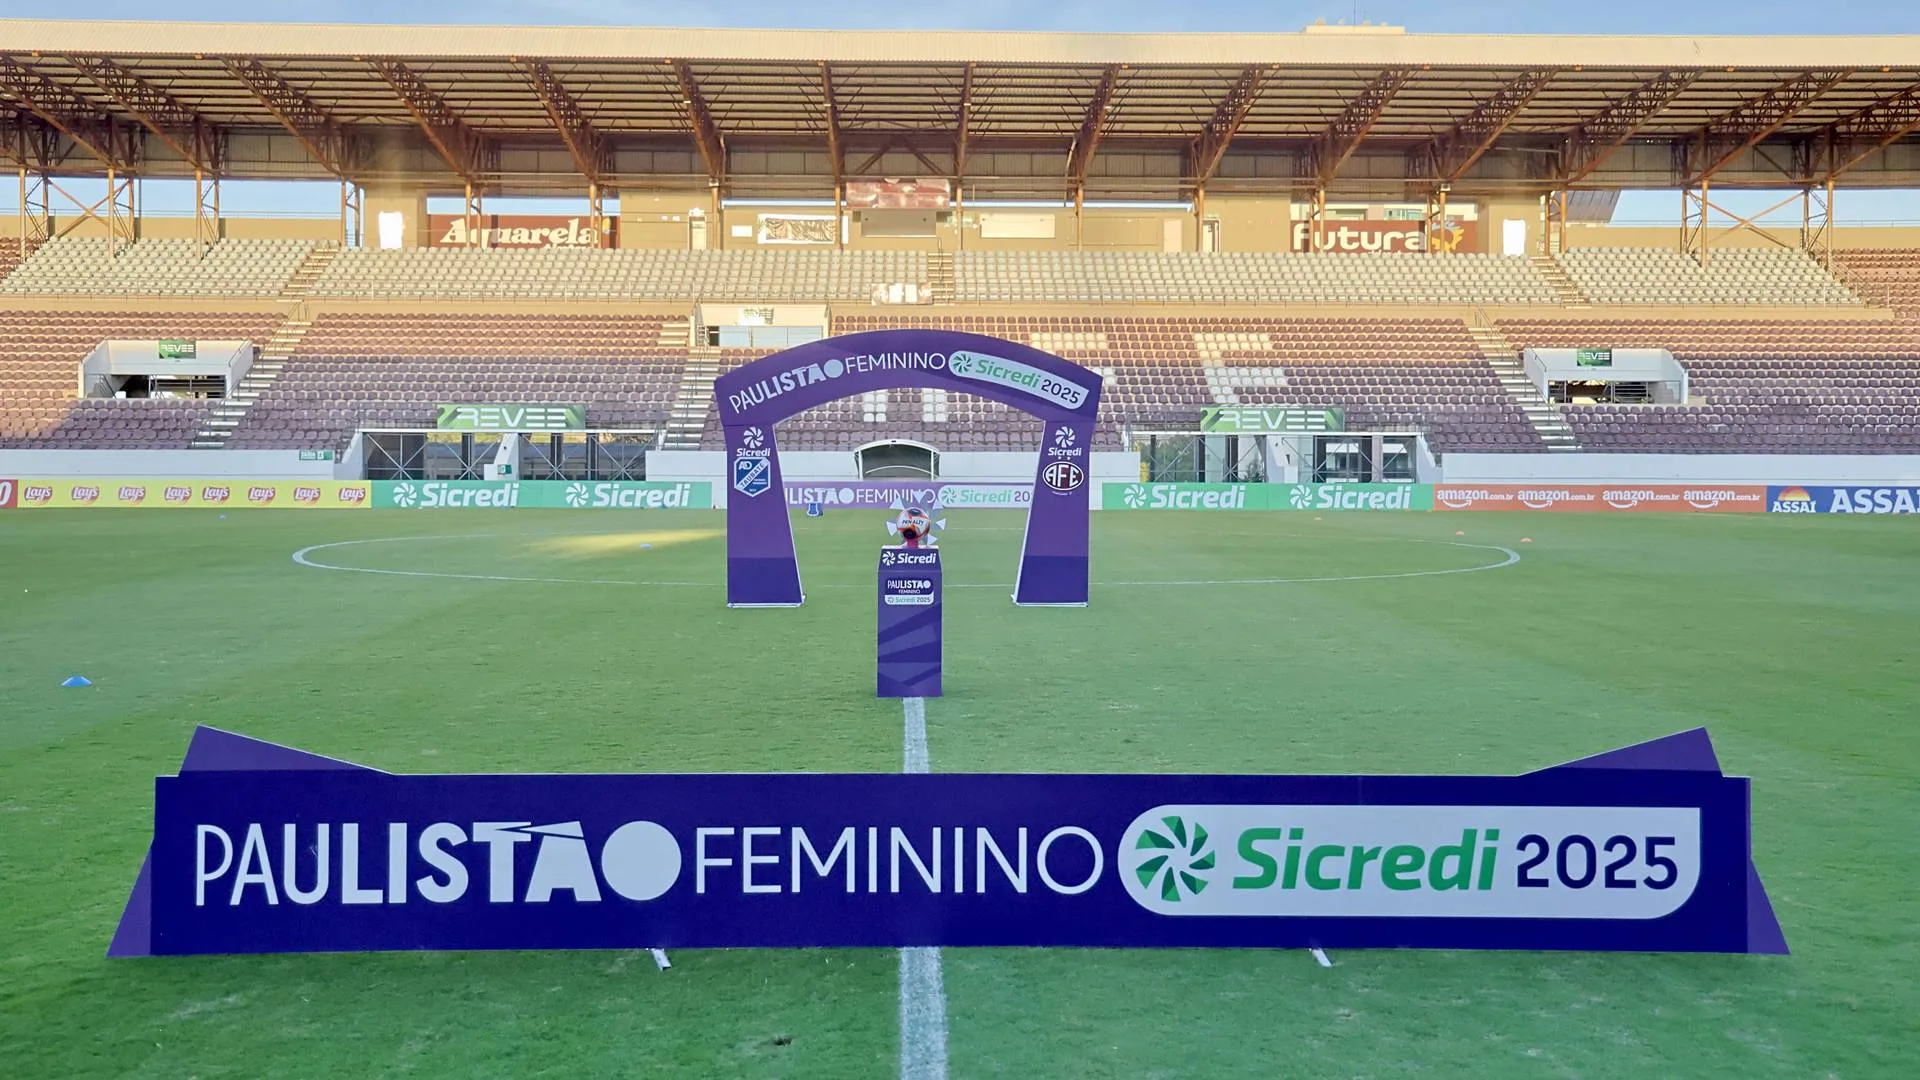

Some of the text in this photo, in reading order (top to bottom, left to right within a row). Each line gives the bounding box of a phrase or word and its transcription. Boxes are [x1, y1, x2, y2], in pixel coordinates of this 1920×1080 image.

[1293, 223, 1427, 250] futura
[845, 352, 946, 374] FEMININO
[975, 359, 1042, 388] Sicredi
[1041, 379, 1081, 404] 2025
[456, 408, 566, 427] REVEE
[1218, 410, 1326, 430] REVEE
[736, 447, 771, 457] Sicredi
[1047, 447, 1082, 456] Sicredi
[1045, 464, 1080, 487] AFE
[421, 483, 519, 507] Sicredi
[592, 484, 690, 507] Sicredi
[960, 490, 1012, 503] Sicredi
[1014, 491, 1031, 502] 20
[1150, 485, 1246, 509] Sicredi
[1316, 486, 1411, 509] Sicredi
[897, 553, 936, 564] Sicredi
[695, 826, 1104, 895] FEMININO
[1232, 827, 1499, 891] Sicredi
[1516, 834, 1679, 890] 2025
